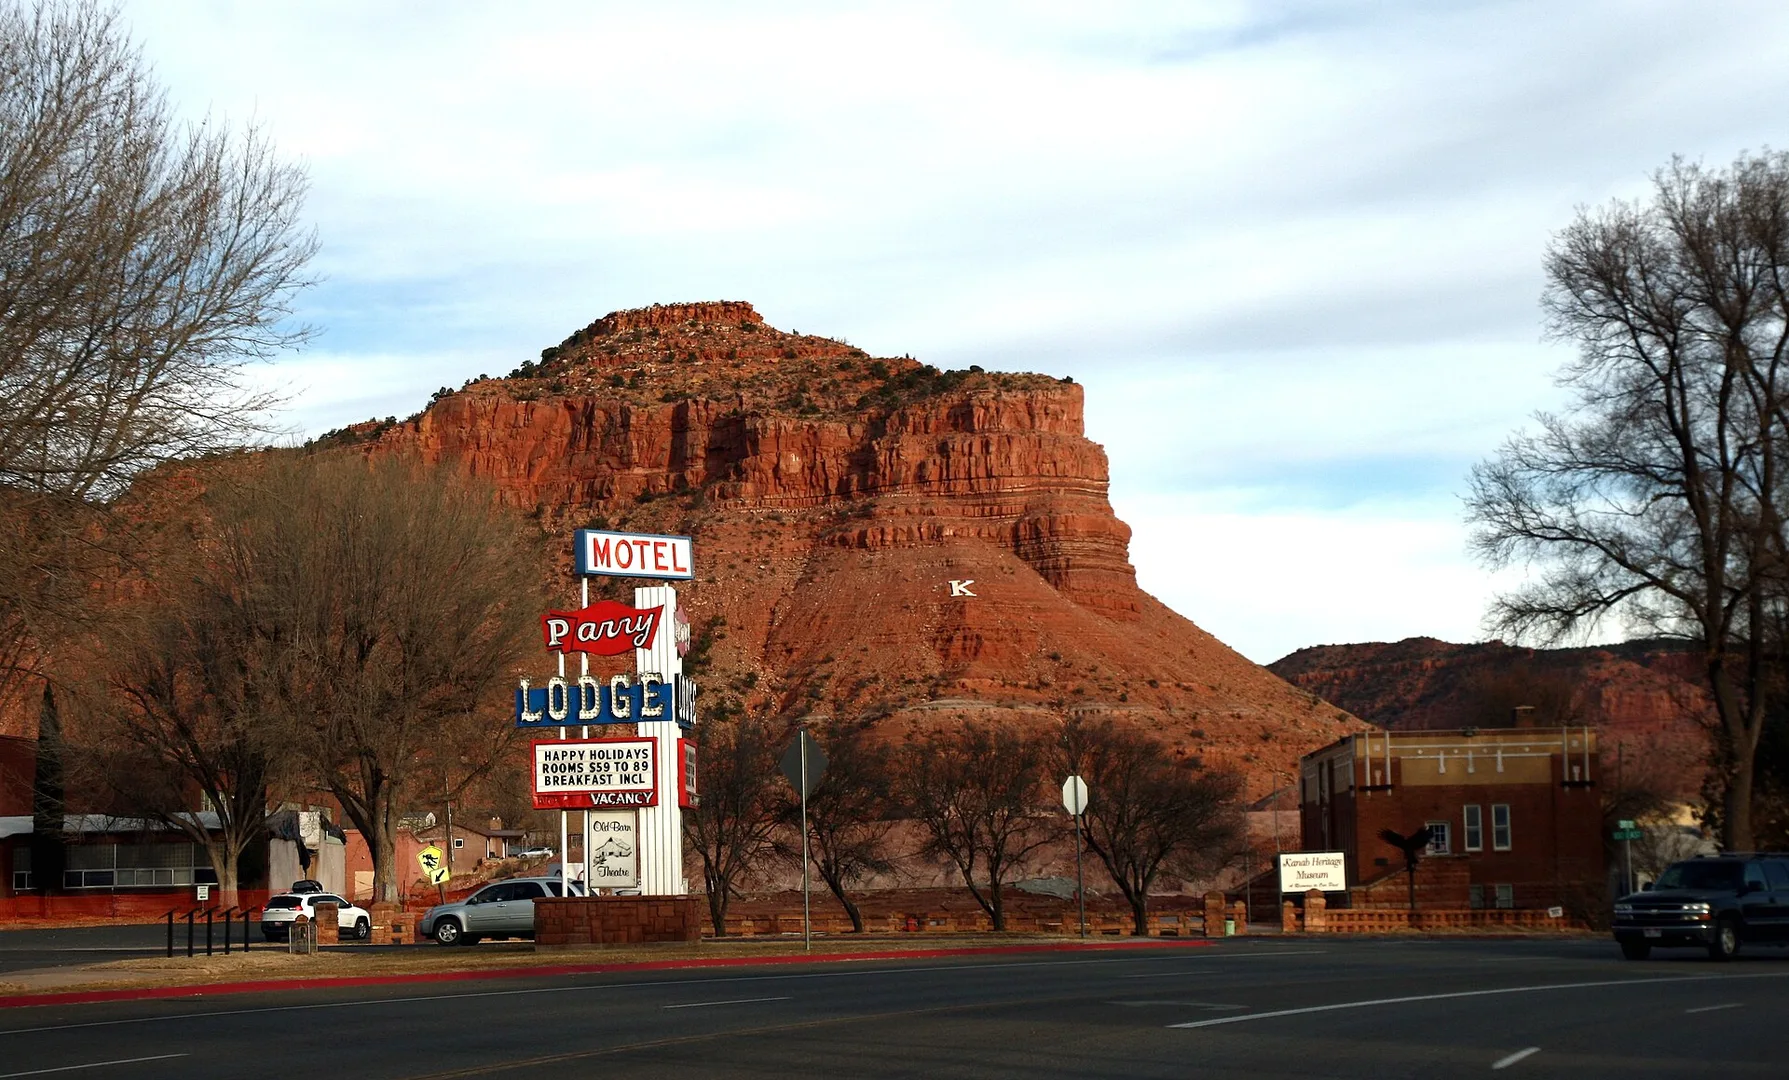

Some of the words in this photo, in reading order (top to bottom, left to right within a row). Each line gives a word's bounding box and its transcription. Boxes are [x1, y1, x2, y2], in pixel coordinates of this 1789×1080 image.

[593, 538, 687, 572] MOTEL
[948, 580, 977, 597] K
[547, 613, 655, 648] Parry
[520, 673, 664, 722] LODGE
[545, 750, 585, 761] HAPPY
[590, 749, 648, 760] HOLIDAYS
[543, 764, 583, 773] ROOMS
[614, 762, 628, 772] TO
[633, 761, 648, 771] 89
[545, 774, 612, 786] BREAKFAST
[620, 773, 645, 784] INCL
[591, 792, 653, 804] VACANCY
[594, 821, 609, 832] Old
[610, 821, 631, 832] Barn
[1283, 858, 1310, 867] Kanab
[1312, 857, 1342, 868] Heritage
[598, 866, 629, 877] Theatre
[1296, 870, 1328, 879] Museum
